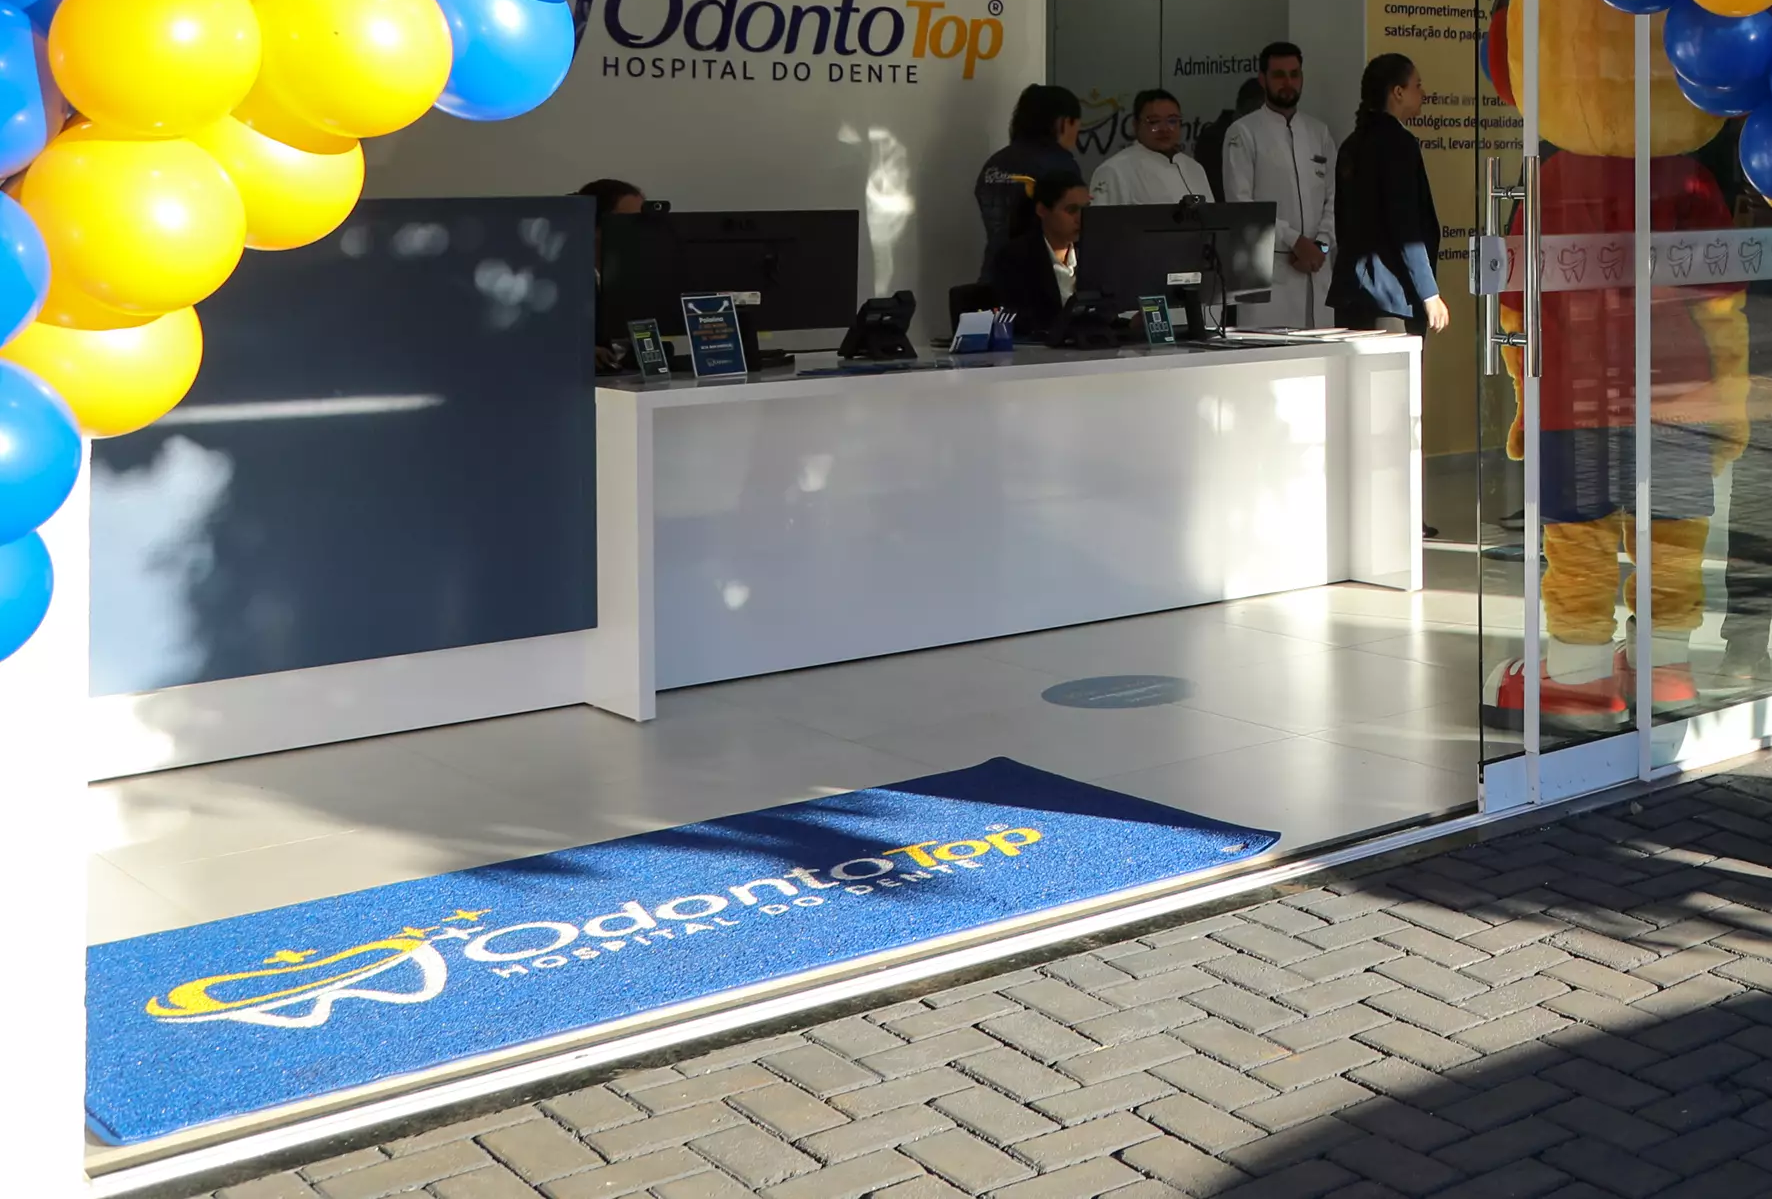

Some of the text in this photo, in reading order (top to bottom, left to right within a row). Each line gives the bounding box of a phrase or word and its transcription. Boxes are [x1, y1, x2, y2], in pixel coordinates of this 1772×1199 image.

[1385, 25, 1441, 41] satisfação
[1443, 27, 1457, 40] do
[603, 56, 918, 83] HOSPITAL DO DENTE
[1174, 54, 1261, 76] Administrat
[1422, 92, 1459, 106] erência
[1405, 115, 1524, 130] ntológicos de qualidad
[1494, 137, 1524, 150] sorris
[1442, 225, 1466, 238] Bem
[491, 859, 983, 978] HOSPITAL DO DENTE
